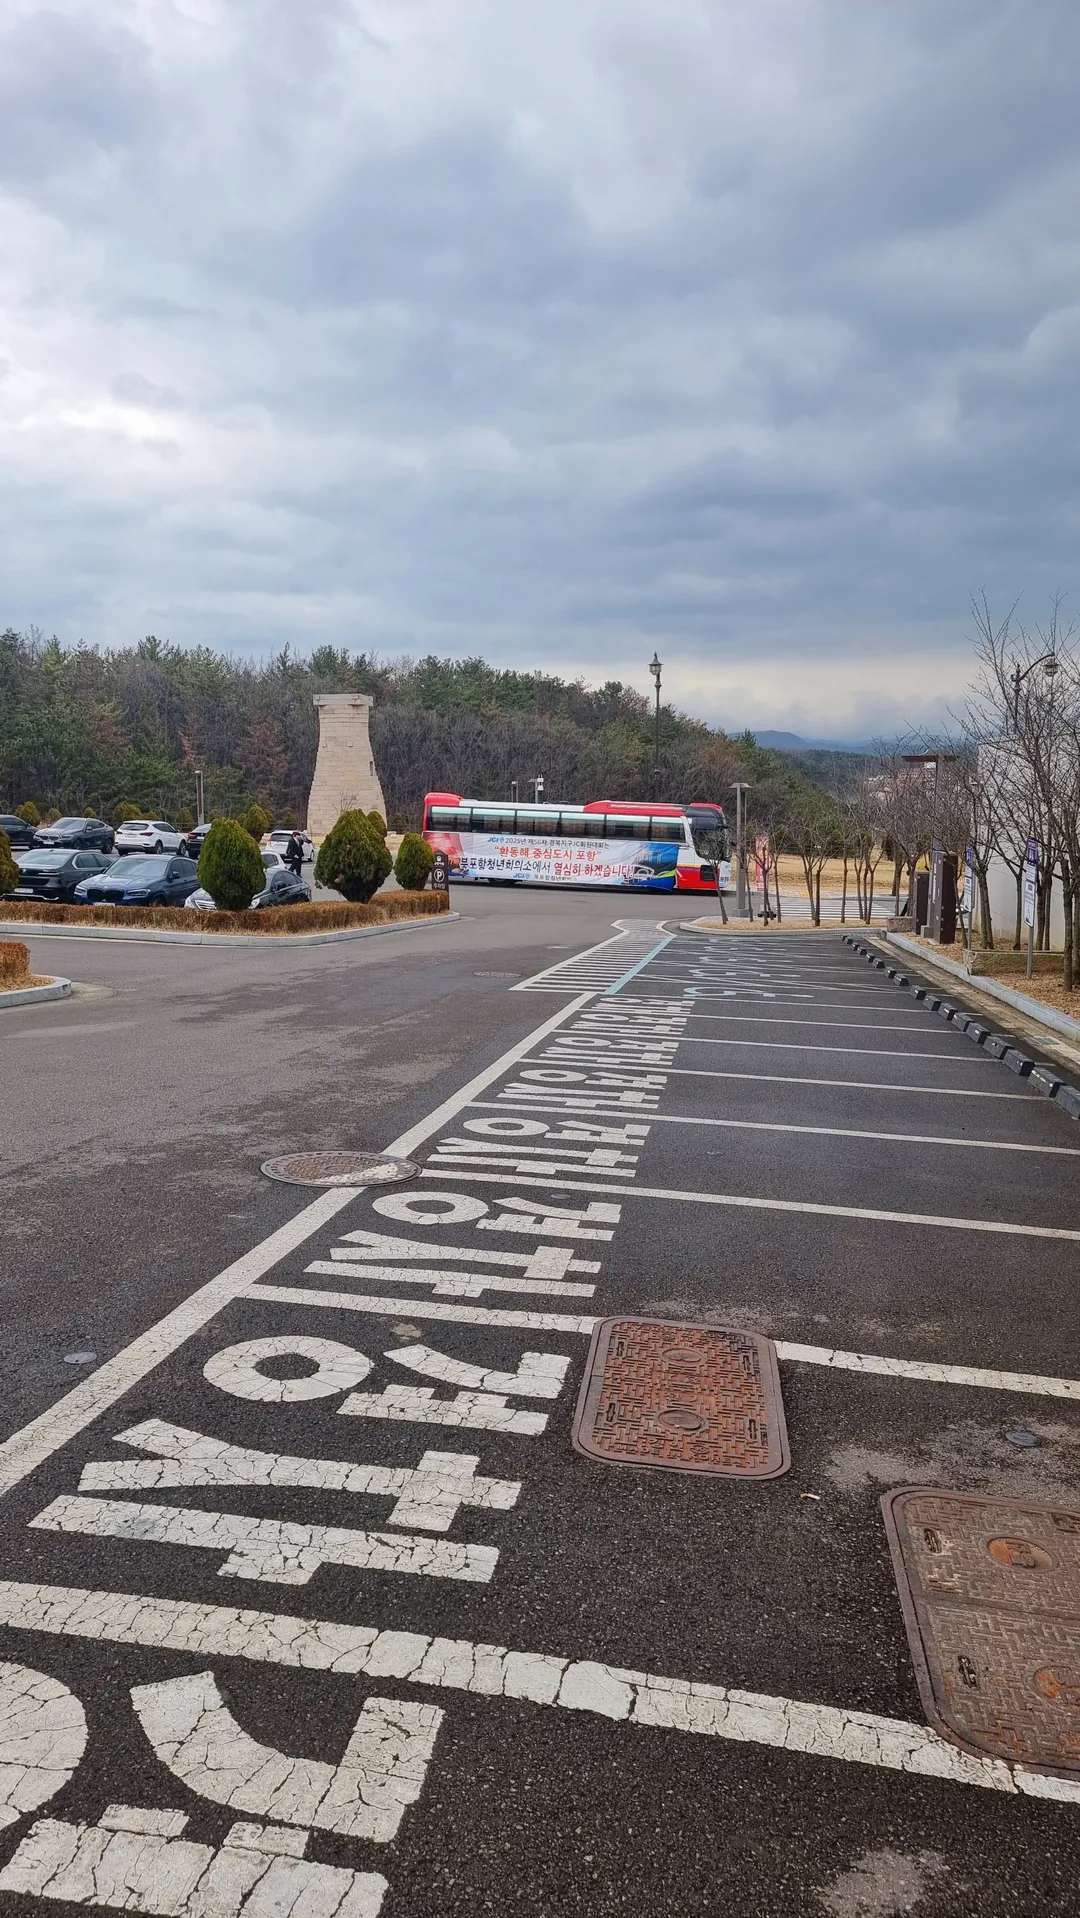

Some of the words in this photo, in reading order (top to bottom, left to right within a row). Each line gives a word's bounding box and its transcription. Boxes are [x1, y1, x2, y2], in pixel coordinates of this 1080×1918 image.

[505, 837, 526, 845] 2025년
[532, 849, 573, 860] 중심도시
[459, 857, 551, 873] 북포항청년회의소에서
[554, 862, 581, 876] 열심히
[0, 1661, 446, 1918] 경
